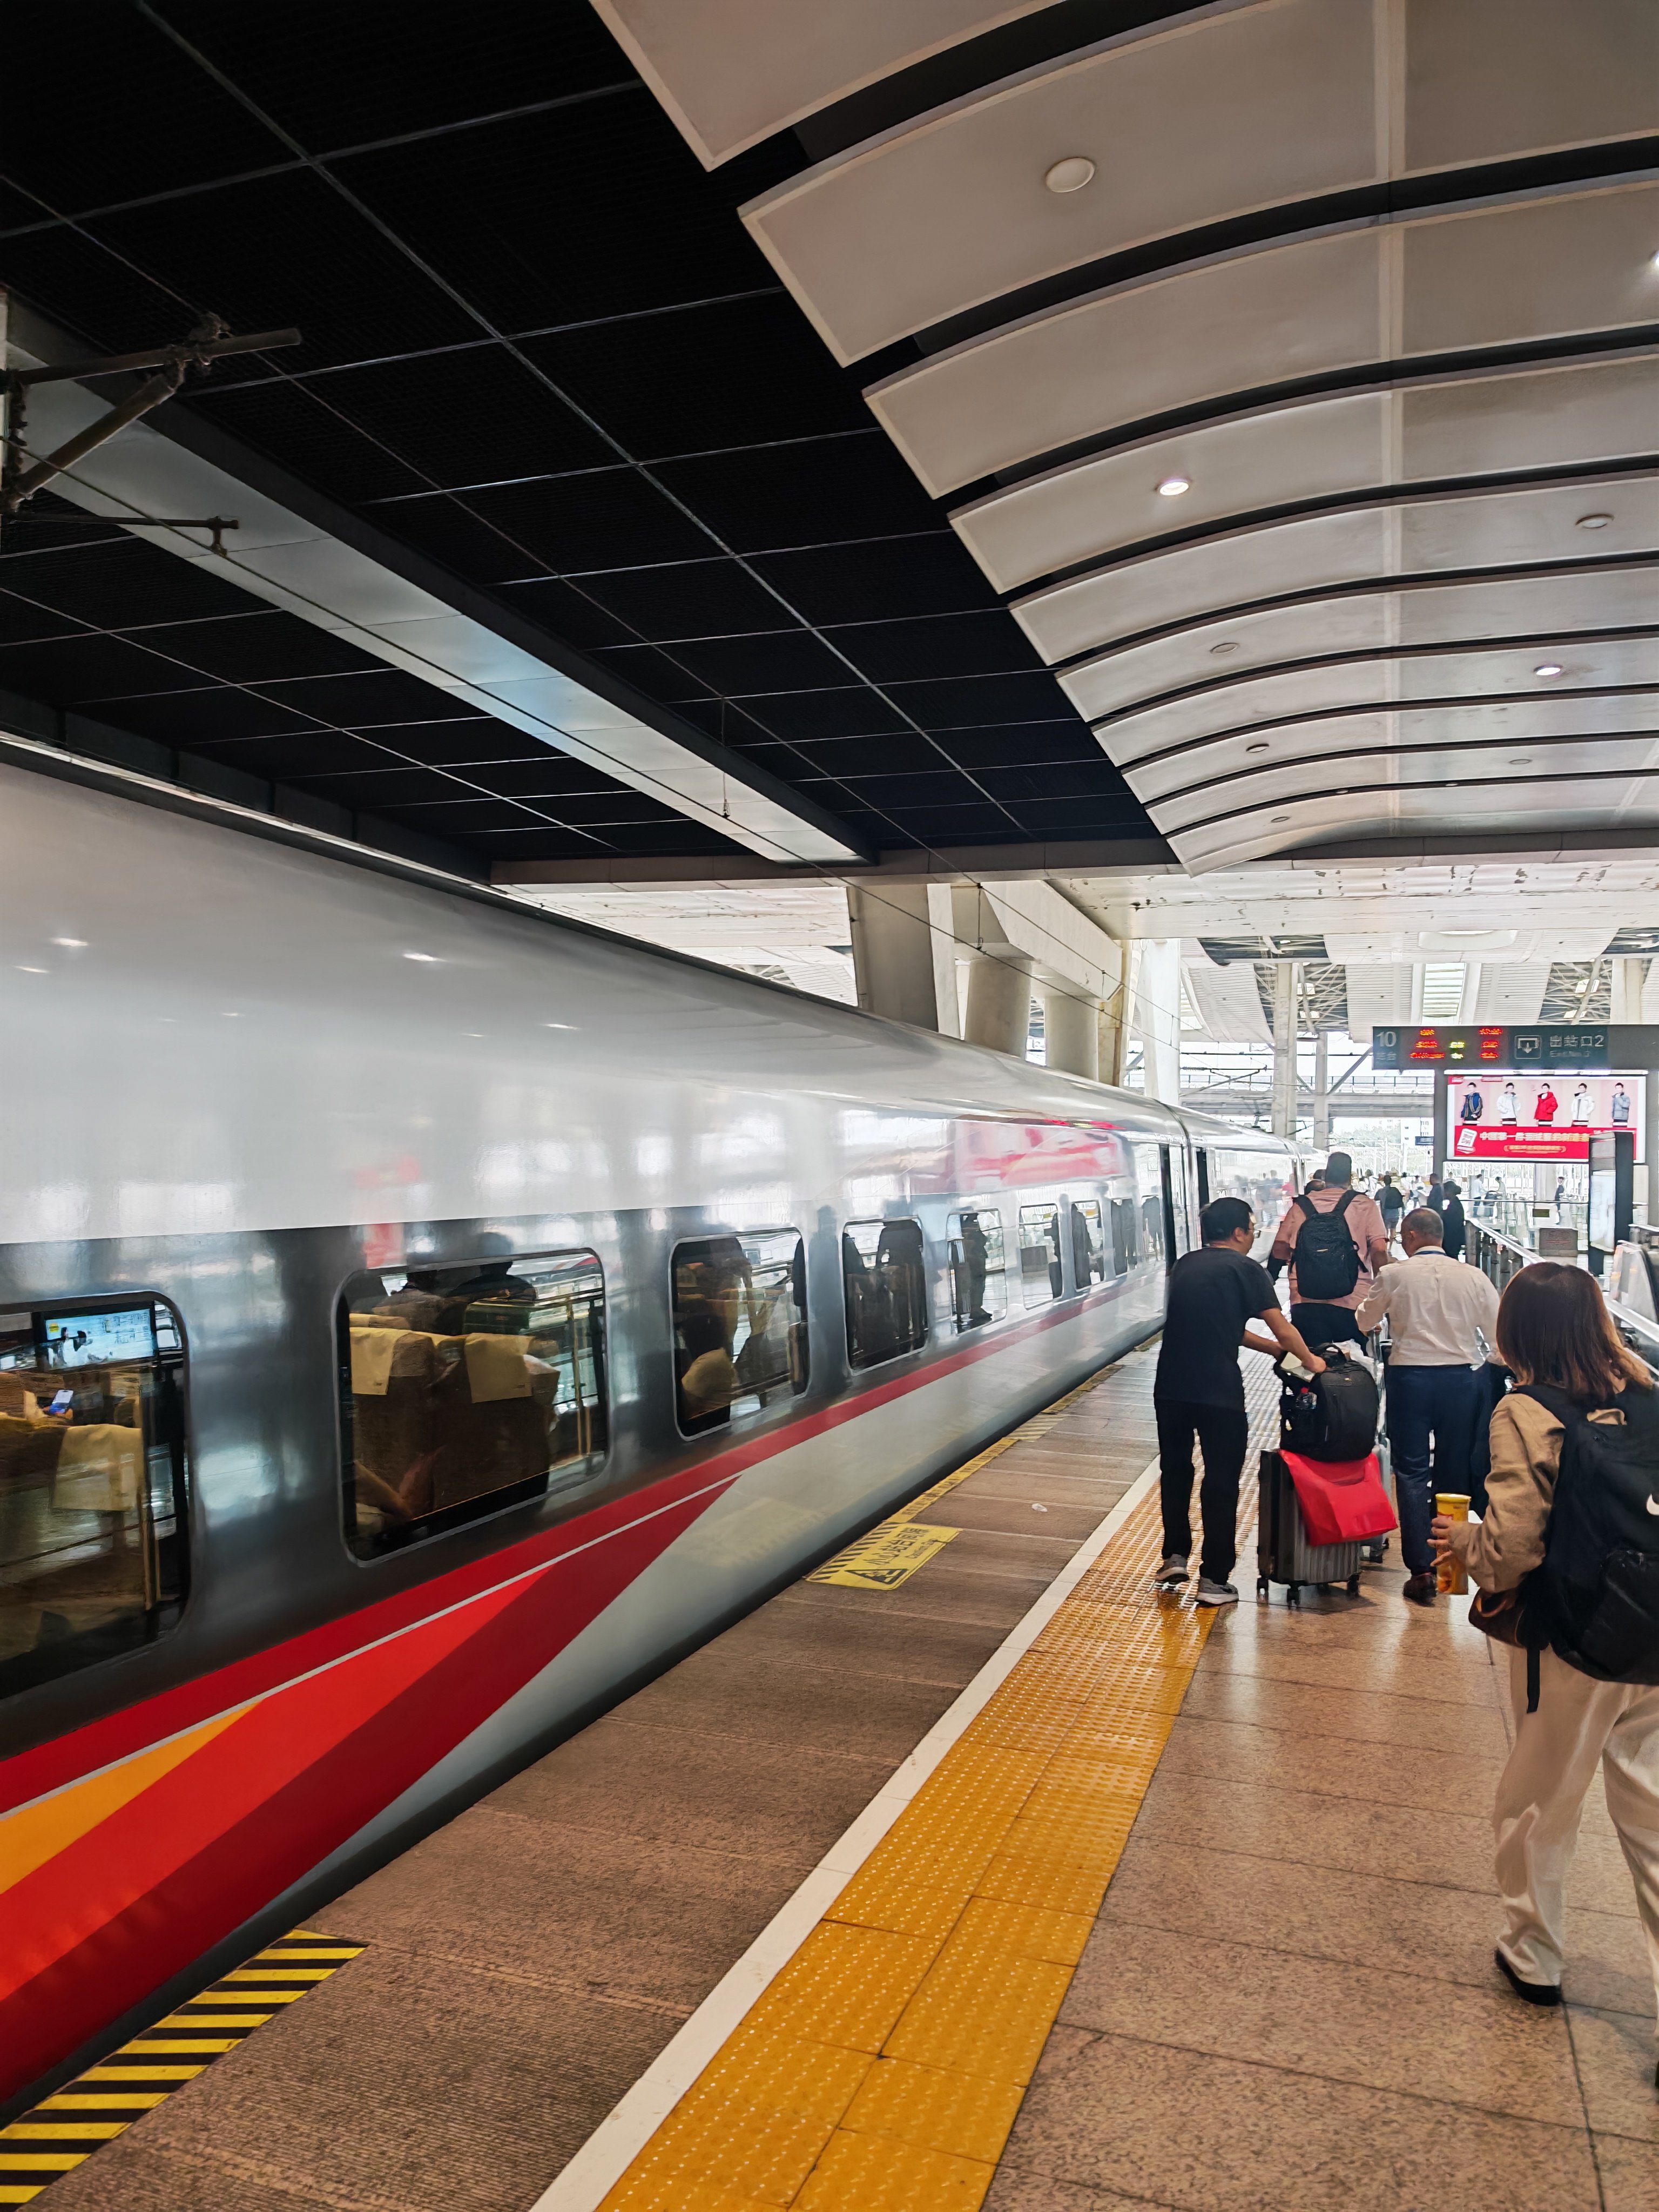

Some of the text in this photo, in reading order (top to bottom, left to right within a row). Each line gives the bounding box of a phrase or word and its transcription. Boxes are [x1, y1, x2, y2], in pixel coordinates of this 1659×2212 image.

[1376, 1031, 1397, 1047] 10
[862, 1527, 930, 1566] 小心站台间隙
